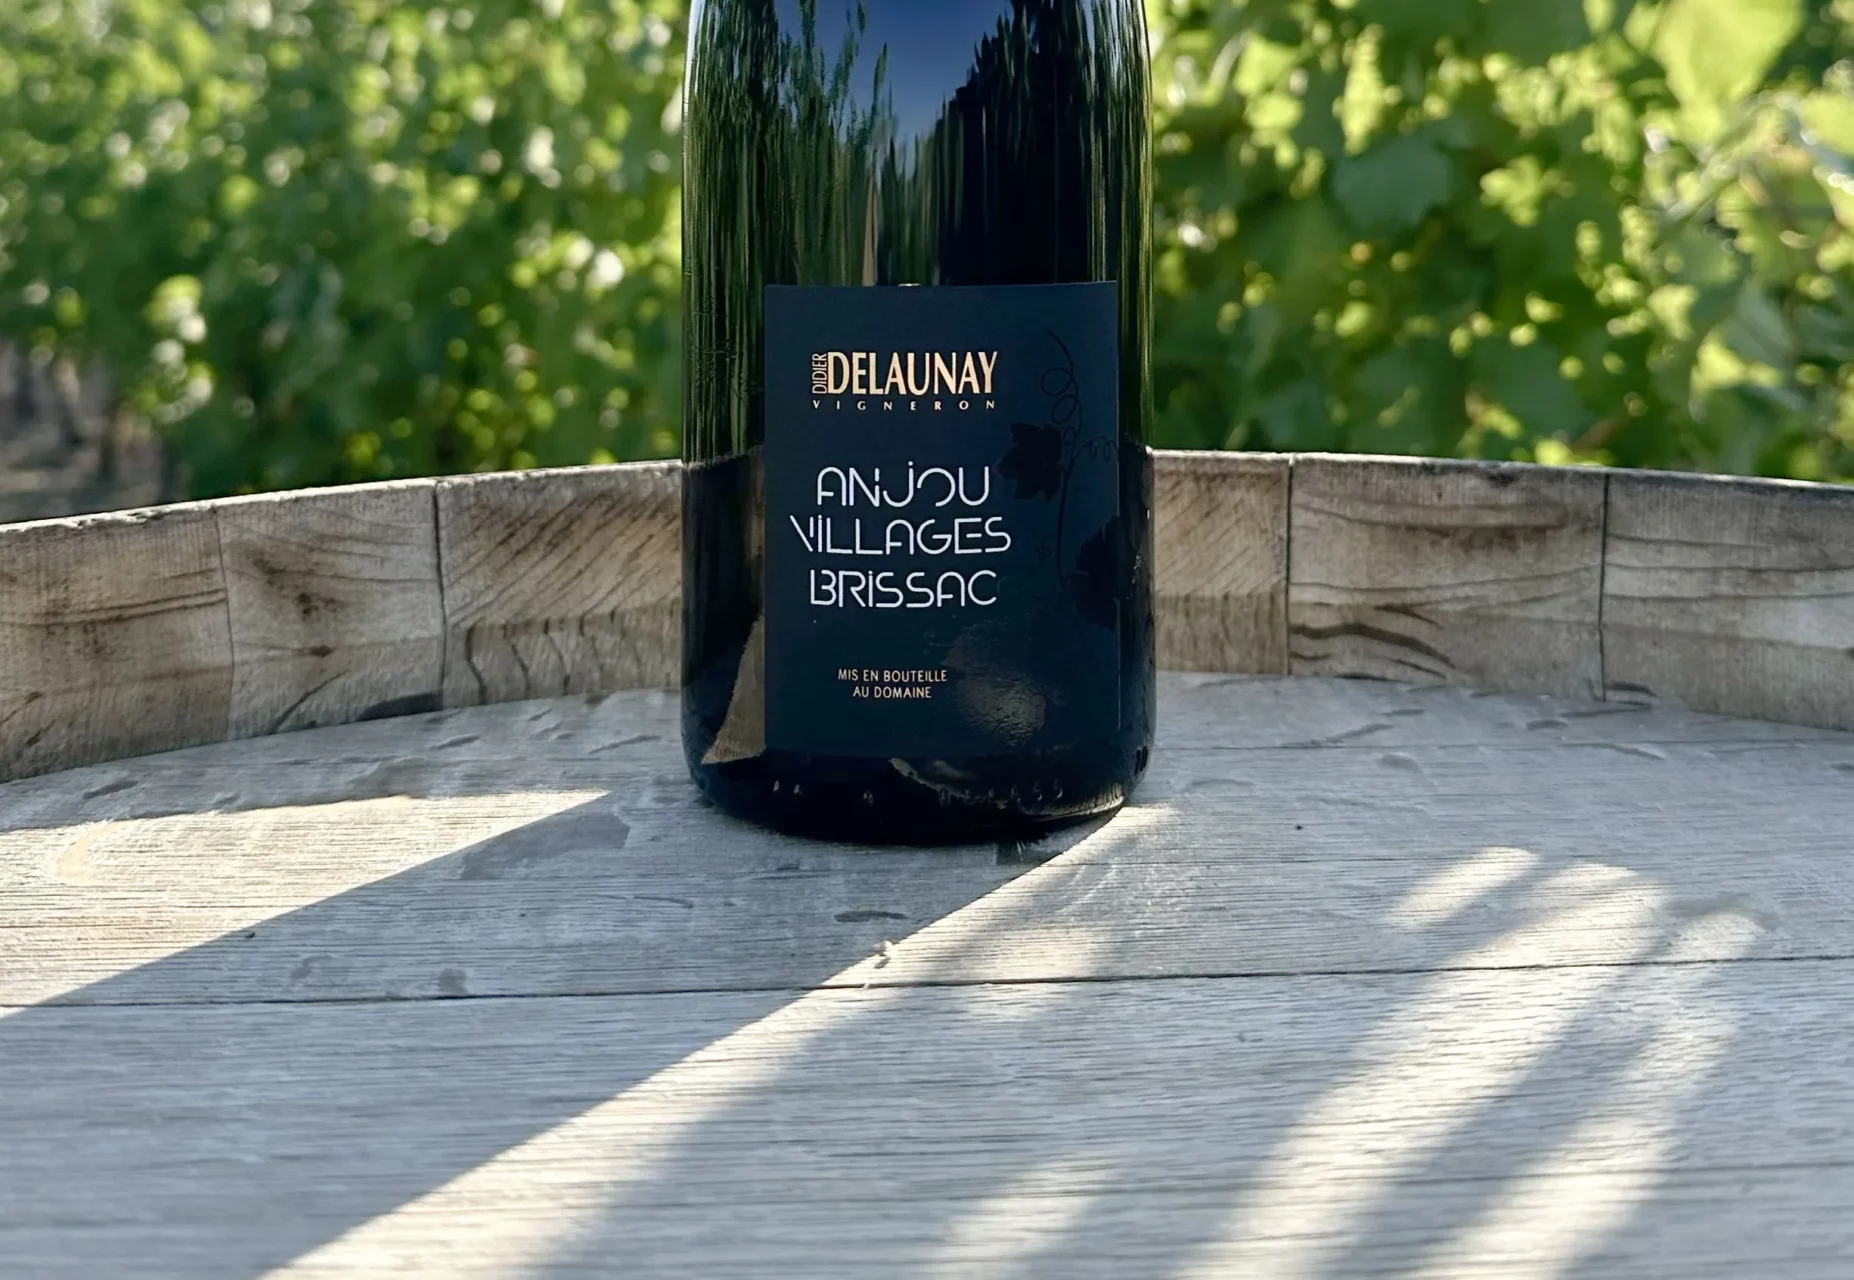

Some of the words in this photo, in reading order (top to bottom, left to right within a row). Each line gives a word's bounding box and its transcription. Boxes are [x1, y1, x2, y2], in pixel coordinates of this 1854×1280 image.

[812, 353, 827, 394] DIDIER
[828, 351, 997, 395] DELAUNAY
[813, 400, 994, 411] VIGNERON
[838, 669, 858, 681] MIS
[864, 670, 878, 681] EN
[884, 670, 947, 682] BOUTEILLE
[853, 686, 869, 697] AU
[874, 686, 931, 698] DOMAINE
